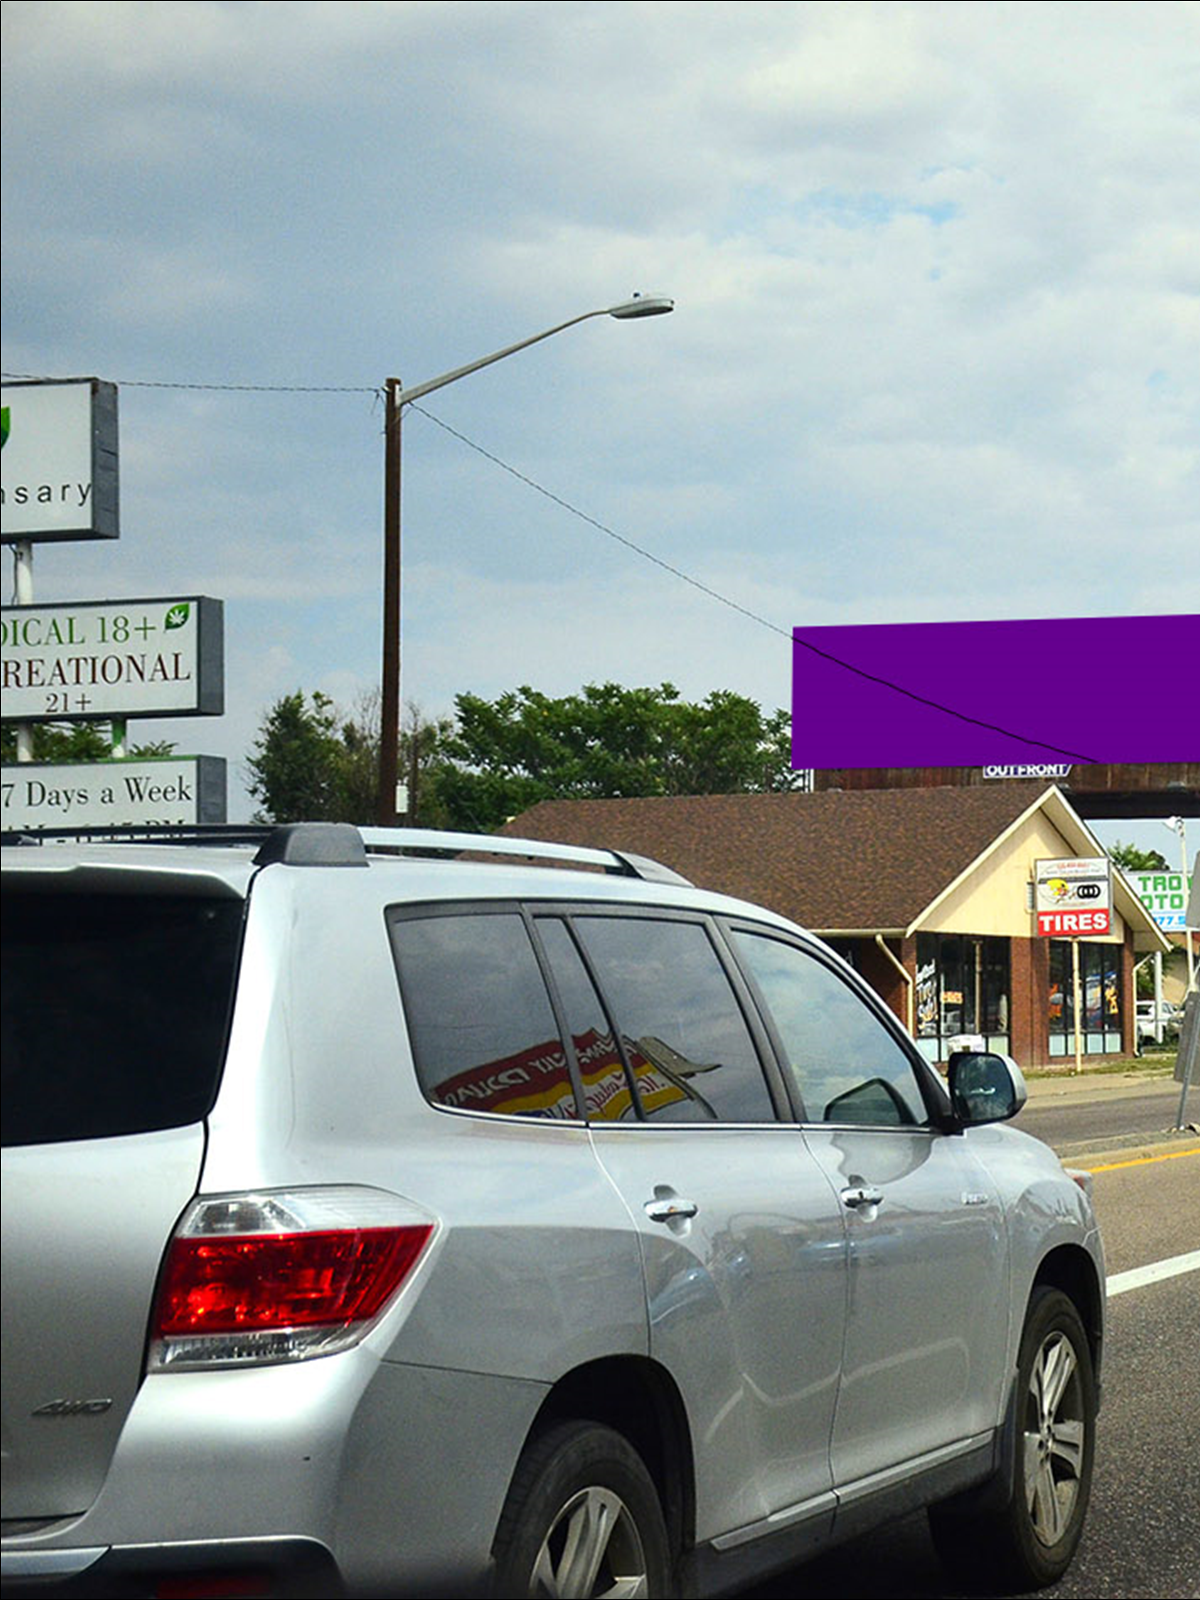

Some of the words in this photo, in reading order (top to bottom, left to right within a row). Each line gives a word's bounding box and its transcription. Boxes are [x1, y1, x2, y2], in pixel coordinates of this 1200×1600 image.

[97, 615, 156, 643] 18+
[3, 652, 191, 688] REATIONAL
[46, 692, 91, 713] 21+
[986, 763, 1069, 776] OUTFRONT
[1, 784, 15, 808] 7
[26, 781, 88, 813] Days
[100, 787, 114, 804] a
[124, 775, 192, 803] Week
[1040, 913, 1107, 932] TIRES
